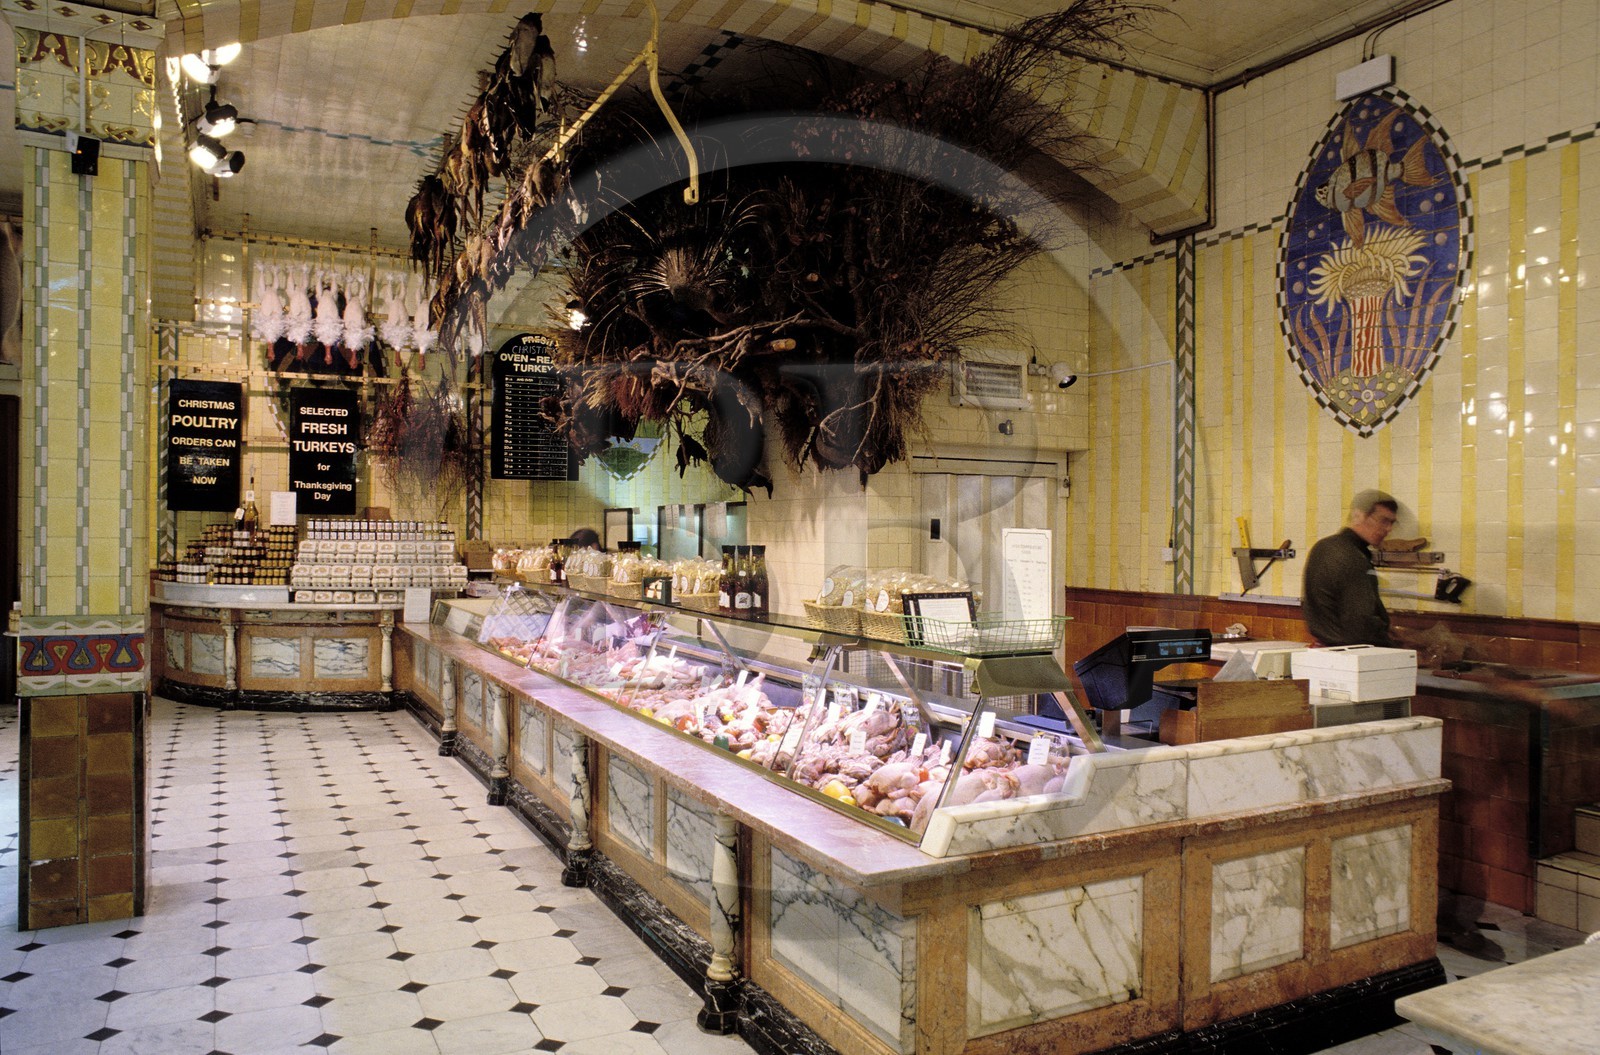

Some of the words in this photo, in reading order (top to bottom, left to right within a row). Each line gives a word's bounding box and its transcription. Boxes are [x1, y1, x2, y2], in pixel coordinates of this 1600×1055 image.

[178, 399, 235, 410] CHRISTMAS
[300, 407, 348, 417] SELECTED
[172, 415, 238, 430] POULTRY
[302, 422, 348, 435] FRESH
[171, 437, 213, 447] ORDERS
[215, 439, 236, 448] CAN
[293, 440, 355, 454] TURKEYS
[179, 457, 193, 465] BE
[198, 457, 230, 467] TAKEN
[317, 463, 330, 471] for
[193, 476, 217, 485] NOW
[294, 480, 352, 491] Thanksgiving
[314, 492, 331, 501] Day
